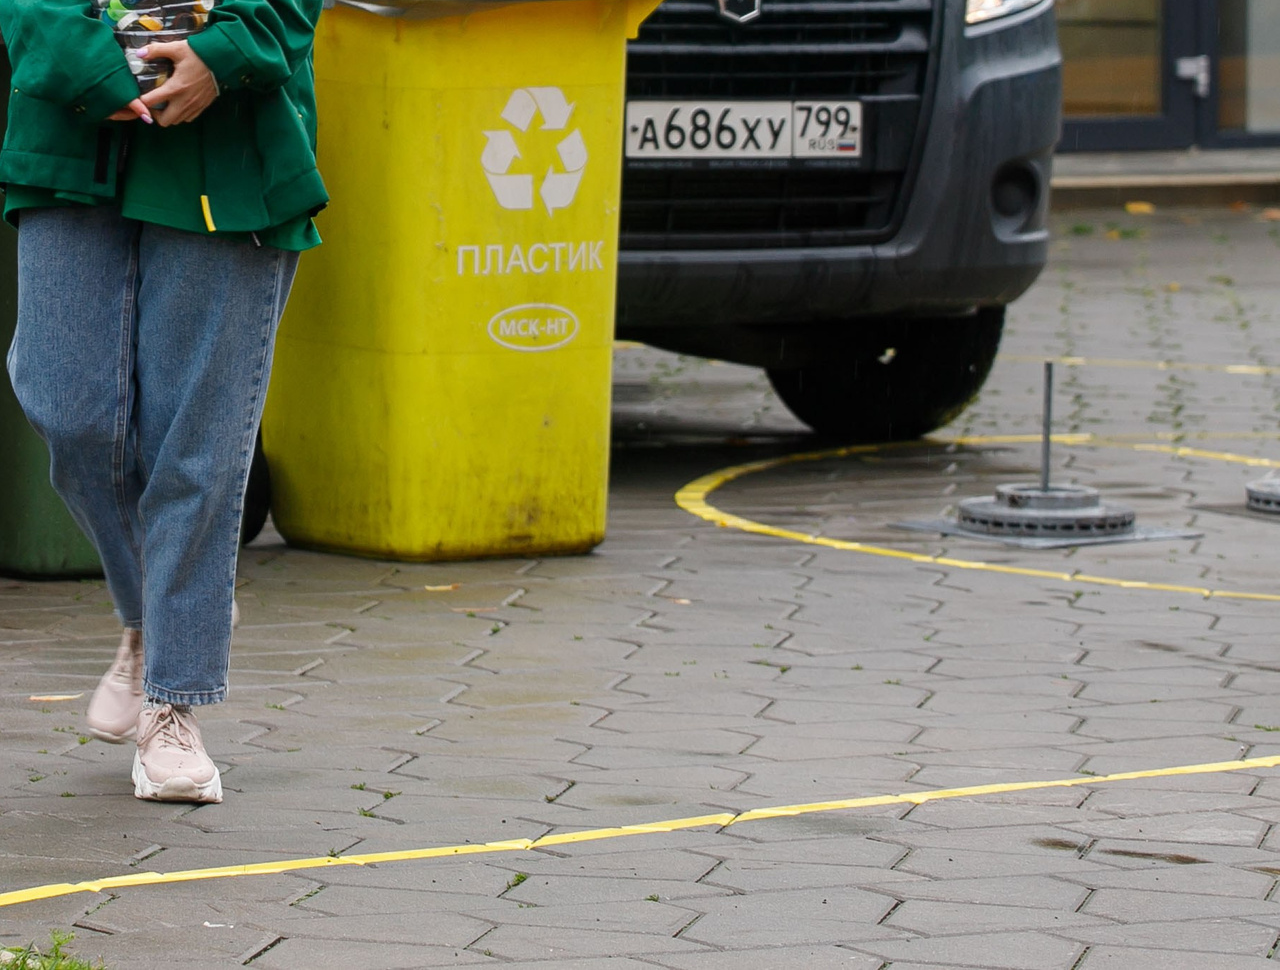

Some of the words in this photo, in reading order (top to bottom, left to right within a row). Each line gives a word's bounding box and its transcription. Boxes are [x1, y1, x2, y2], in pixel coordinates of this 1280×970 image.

[638, 107, 786, 150] А686ХУ
[795, 105, 851, 138] 799
[808, 138, 836, 151] RUS
[457, 240, 604, 276] ПЛАСТИК
[499, 318, 569, 338] МСК-НТ
